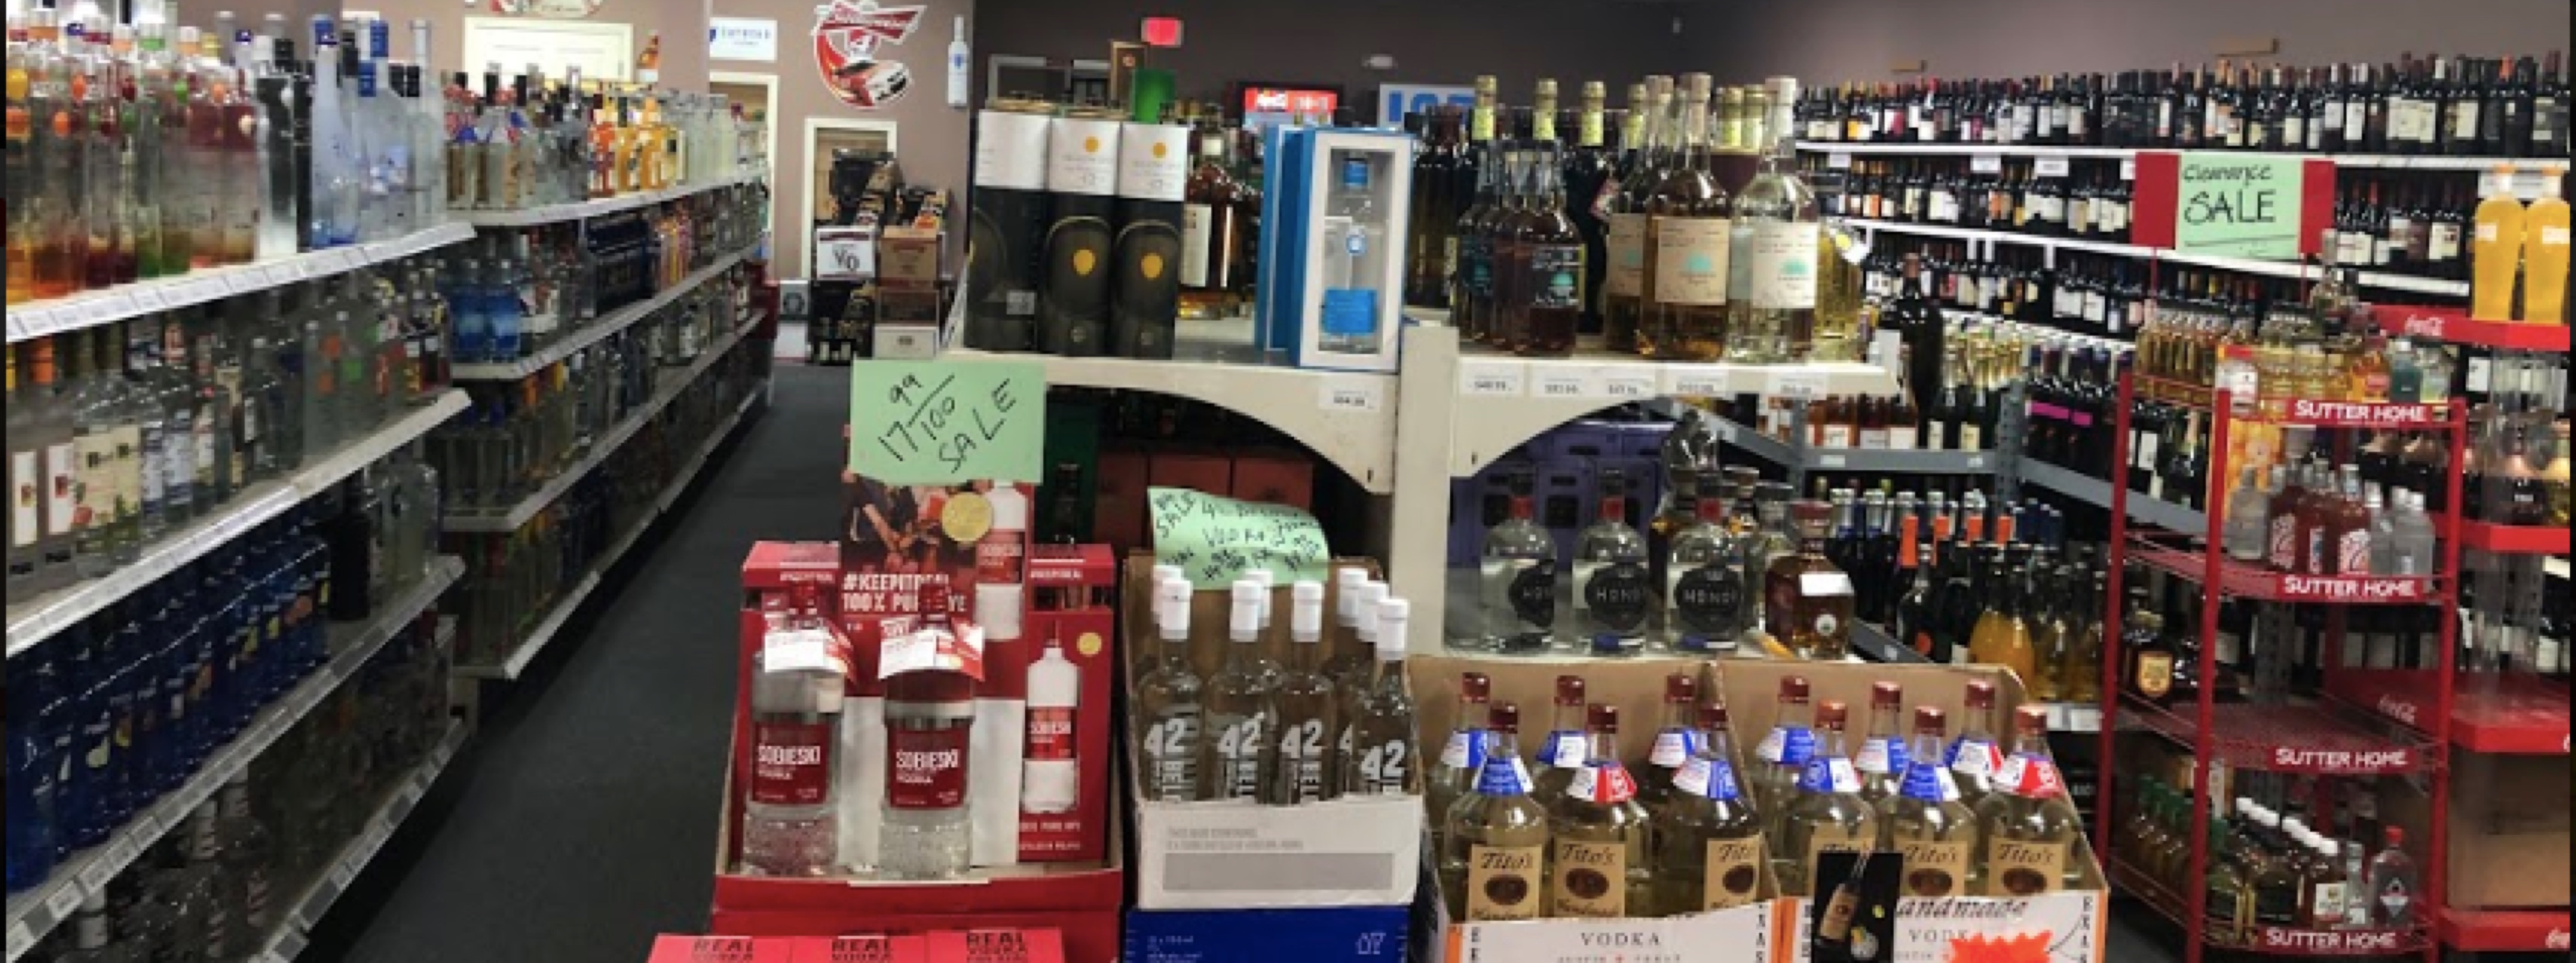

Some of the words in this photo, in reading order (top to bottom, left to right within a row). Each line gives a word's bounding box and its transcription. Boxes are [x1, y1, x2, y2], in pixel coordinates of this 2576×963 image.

[2183, 163, 2272, 187] Clearance
[2184, 189, 2276, 225] SALE
[2295, 400, 2369, 420] SUTTER
[2374, 406, 2426, 422] HOME
[939, 378, 1016, 474] SALE
[2285, 574, 2358, 594] SUTTER
[2364, 579, 2415, 597] HOME
[1144, 718, 1187, 759] 42
[1218, 718, 1260, 759] 42
[1282, 718, 1324, 759] 42
[1340, 724, 1354, 756] 4
[759, 745, 821, 765] SOBIESKI
[895, 749, 959, 768] SOBIESKI
[1361, 739, 1406, 781] 42
[2276, 749, 2351, 766] SUTTER
[2356, 751, 2407, 766] HOME
[1481, 852, 1533, 869] Tito's
[1562, 843, 1615, 866] Tito's
[1997, 842, 2055, 865] Tito's
[1897, 898, 2028, 918] andmade
[832, 939, 891, 952] REAL
[966, 932, 1025, 947] REAL
[1581, 932, 1662, 947] VODKA
[2266, 928, 2340, 947] SUTTER
[2346, 932, 2396, 949] HOME
